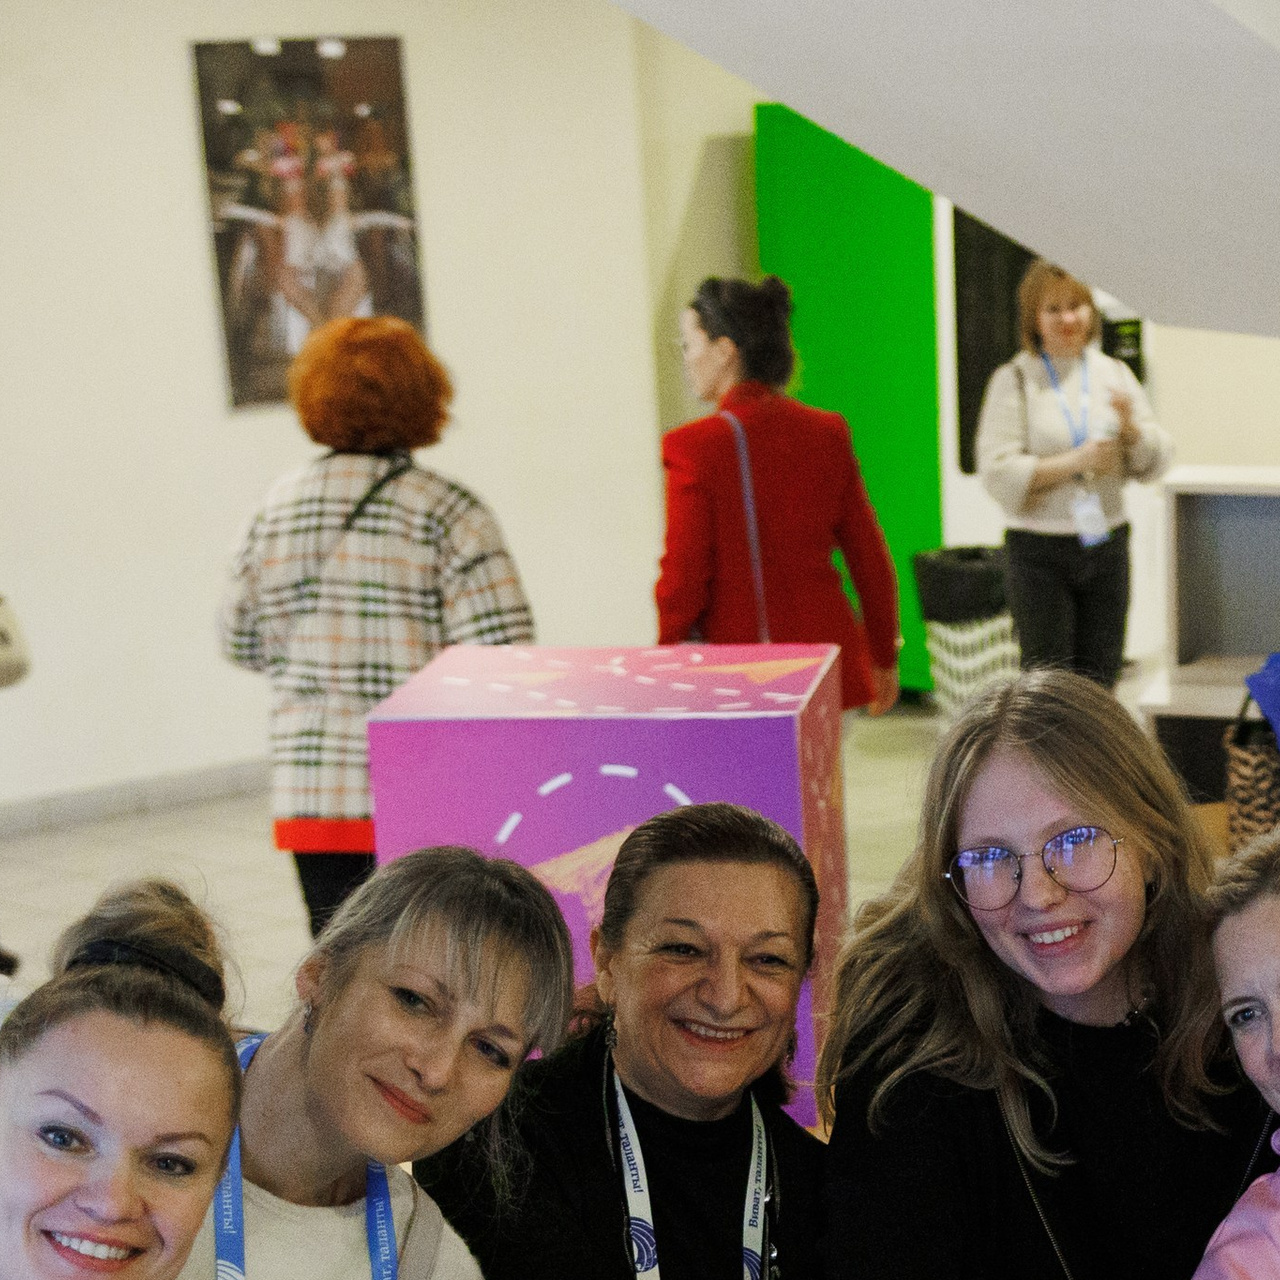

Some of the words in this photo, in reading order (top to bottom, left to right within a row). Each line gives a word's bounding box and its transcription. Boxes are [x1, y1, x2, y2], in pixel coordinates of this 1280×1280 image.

[620, 1133, 644, 1193] таланты!
[375, 1198, 392, 1261] таланты!
[749, 1186, 762, 1229] Виват,
